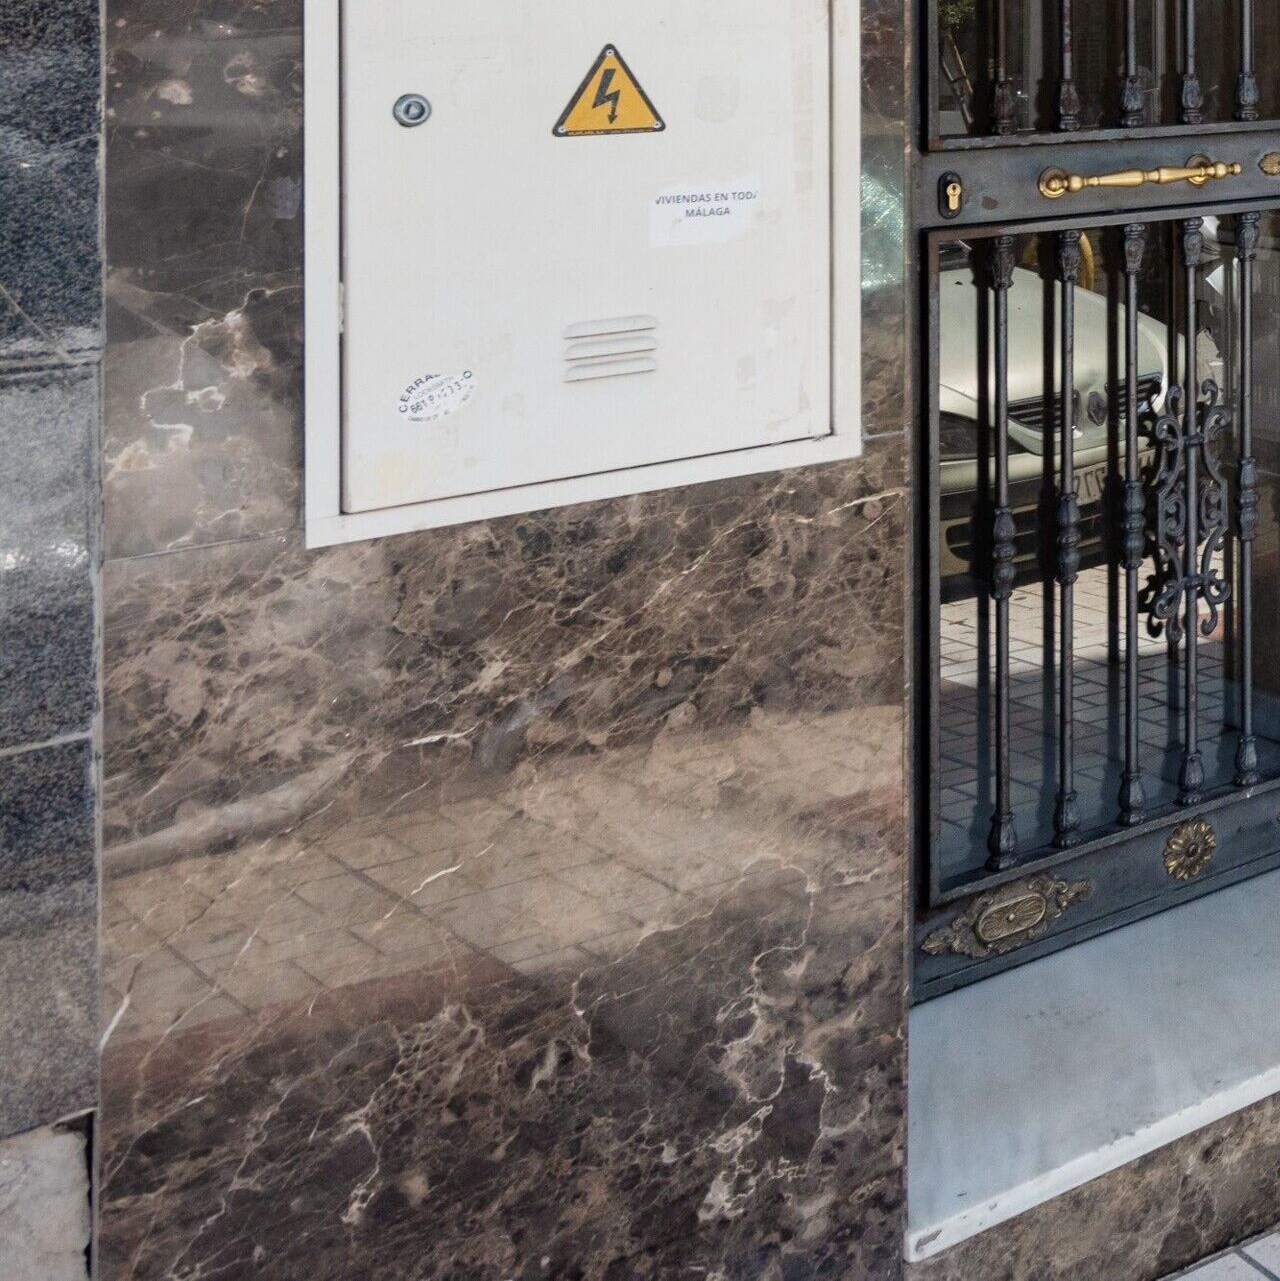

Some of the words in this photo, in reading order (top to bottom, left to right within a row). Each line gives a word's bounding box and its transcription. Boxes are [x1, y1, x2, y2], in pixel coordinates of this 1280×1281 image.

[655, 193, 712, 205] VIVIENDAS
[714, 192, 728, 202] EN
[685, 206, 731, 218] MÁLAGA
